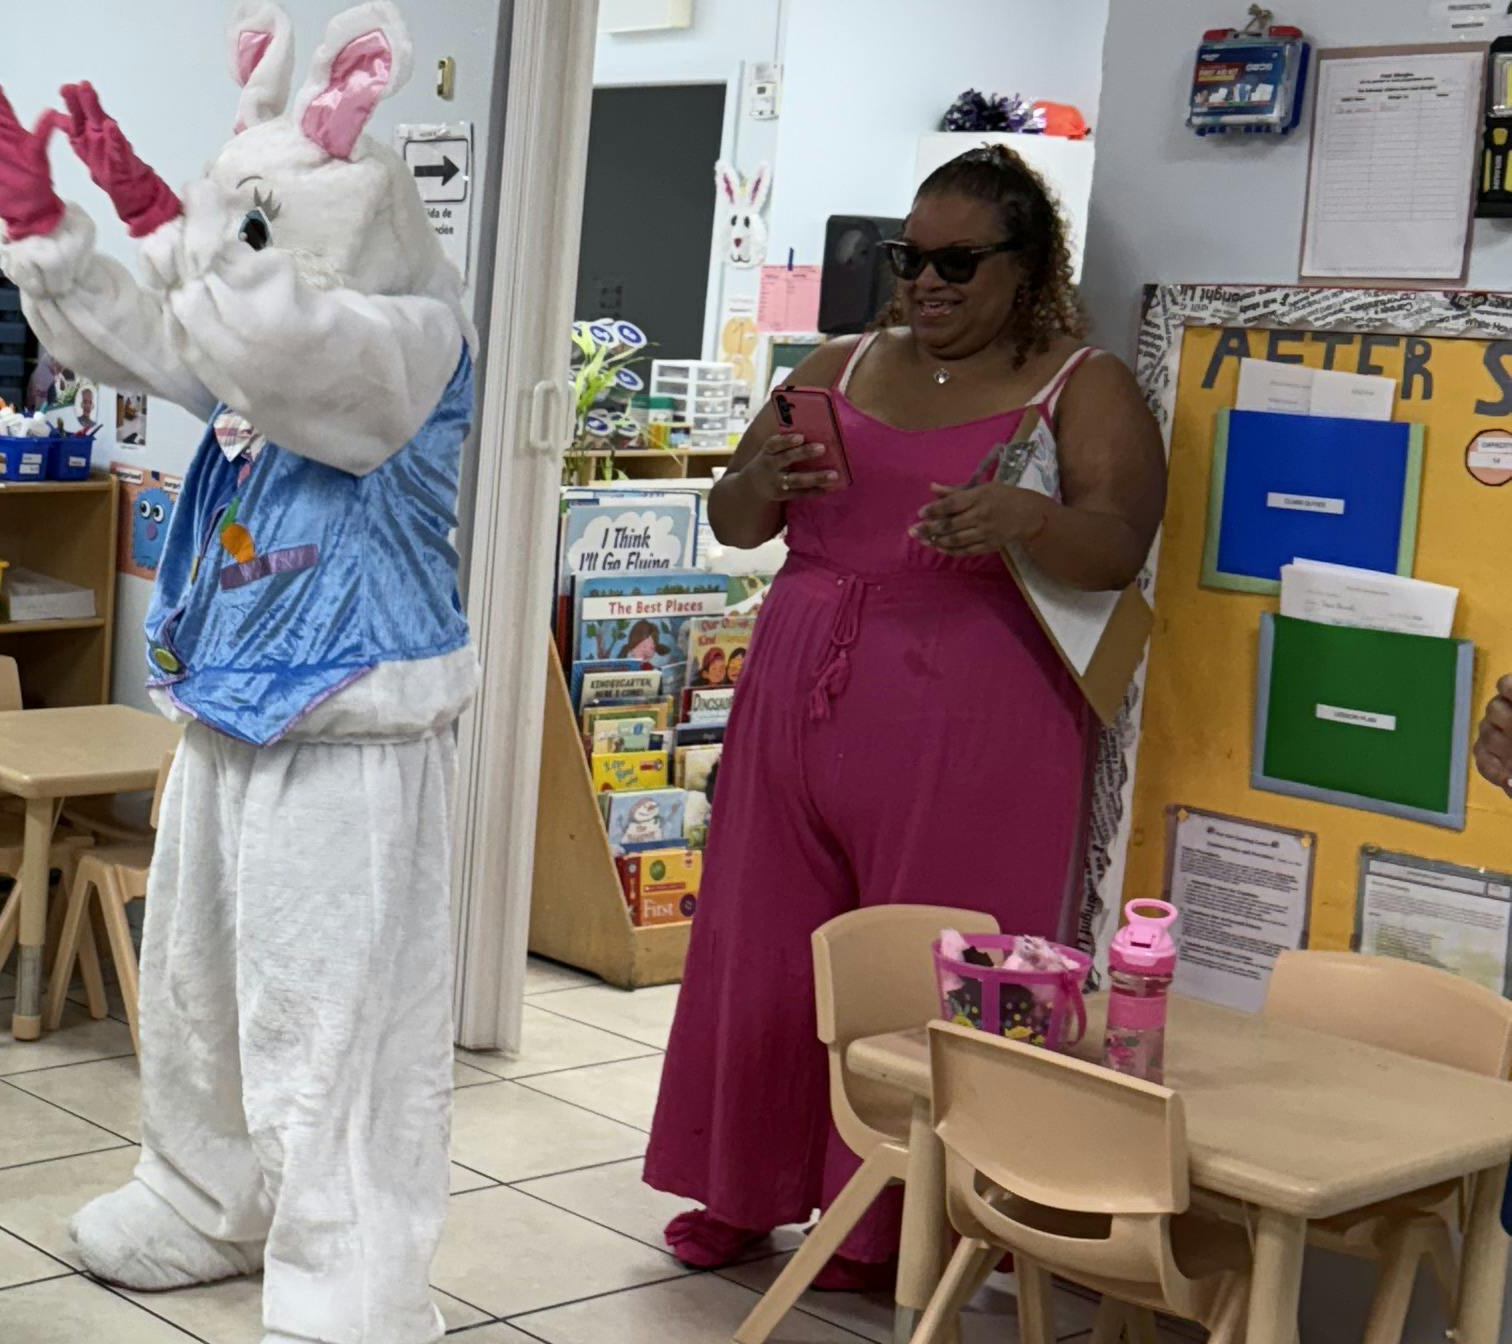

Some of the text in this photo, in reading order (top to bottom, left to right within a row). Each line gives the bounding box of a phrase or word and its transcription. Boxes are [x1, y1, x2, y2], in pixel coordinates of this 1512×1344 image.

[1201, 327, 1433, 401] AFTER
[602, 526, 651, 550] I Think
[579, 552, 599, 572] I'll
[602, 553, 621, 571] Go
[608, 599, 703, 615] The Best Places
[643, 898, 673, 918] First
